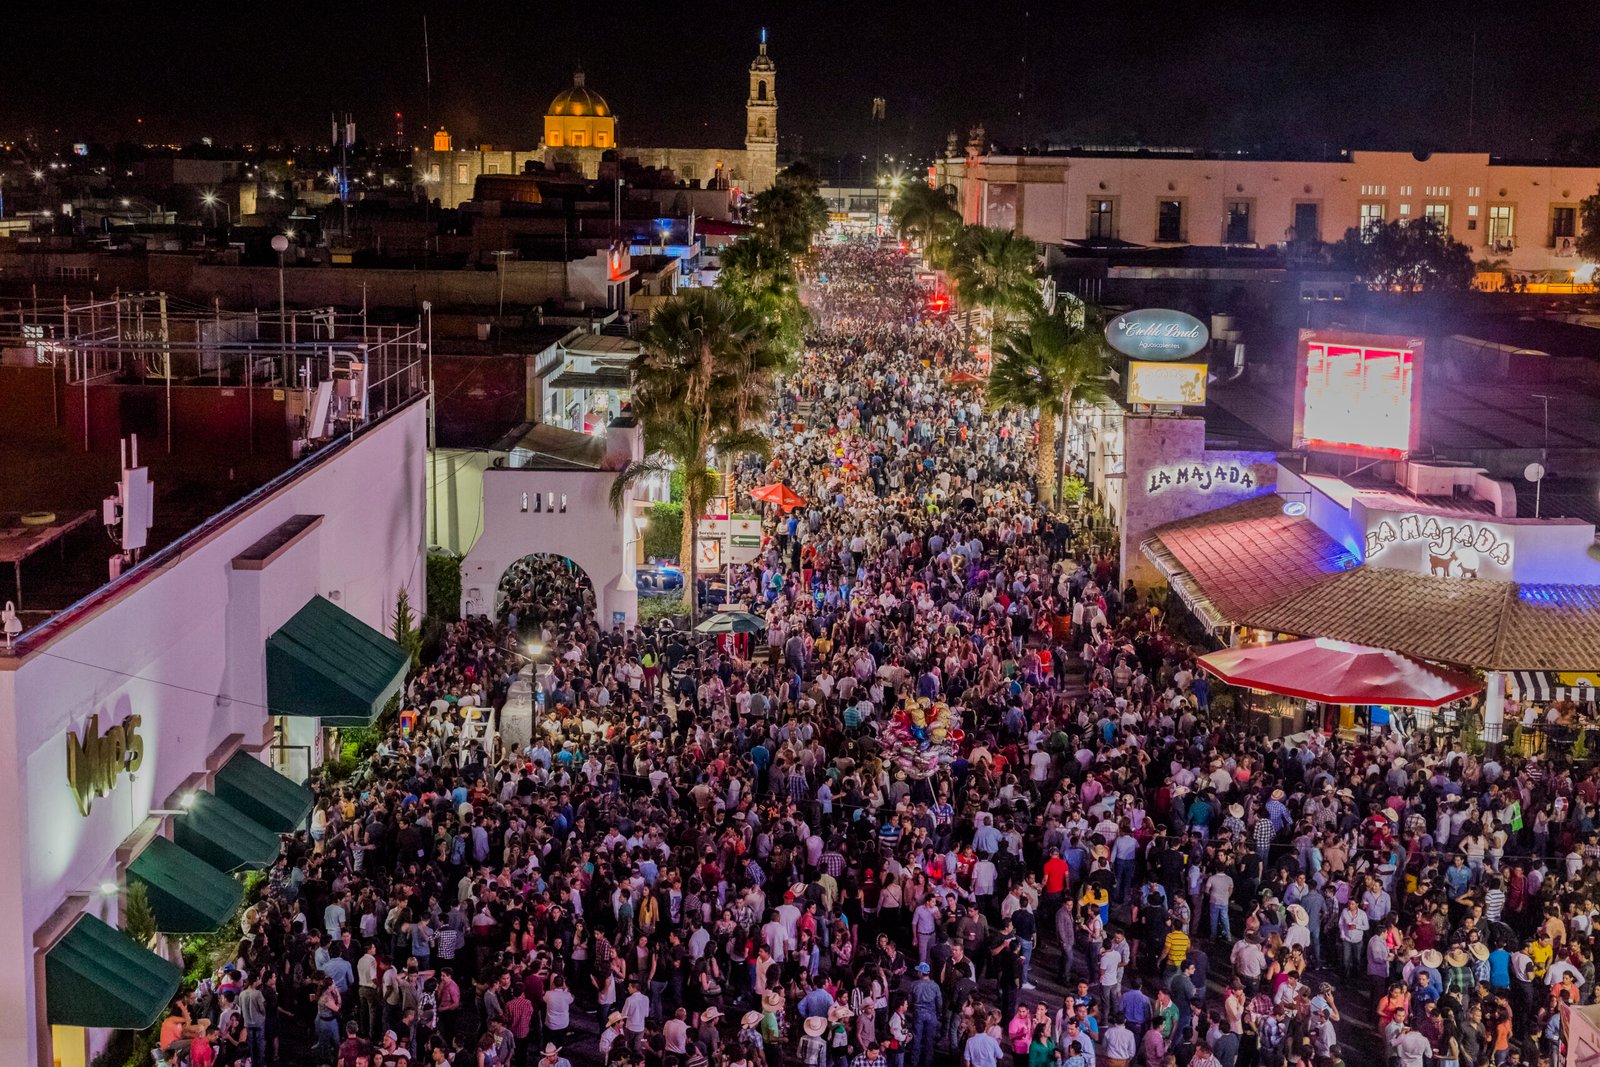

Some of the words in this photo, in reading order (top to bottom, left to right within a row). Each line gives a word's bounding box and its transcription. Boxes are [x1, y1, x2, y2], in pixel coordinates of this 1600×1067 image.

[1165, 323, 1200, 338] Lindo
[1148, 470, 1171, 493] LA
[1176, 466, 1253, 490] MAJADA
[1365, 521, 1397, 558] LA
[1399, 515, 1511, 565] MAJADA
[848, 742, 854, 750] 9
